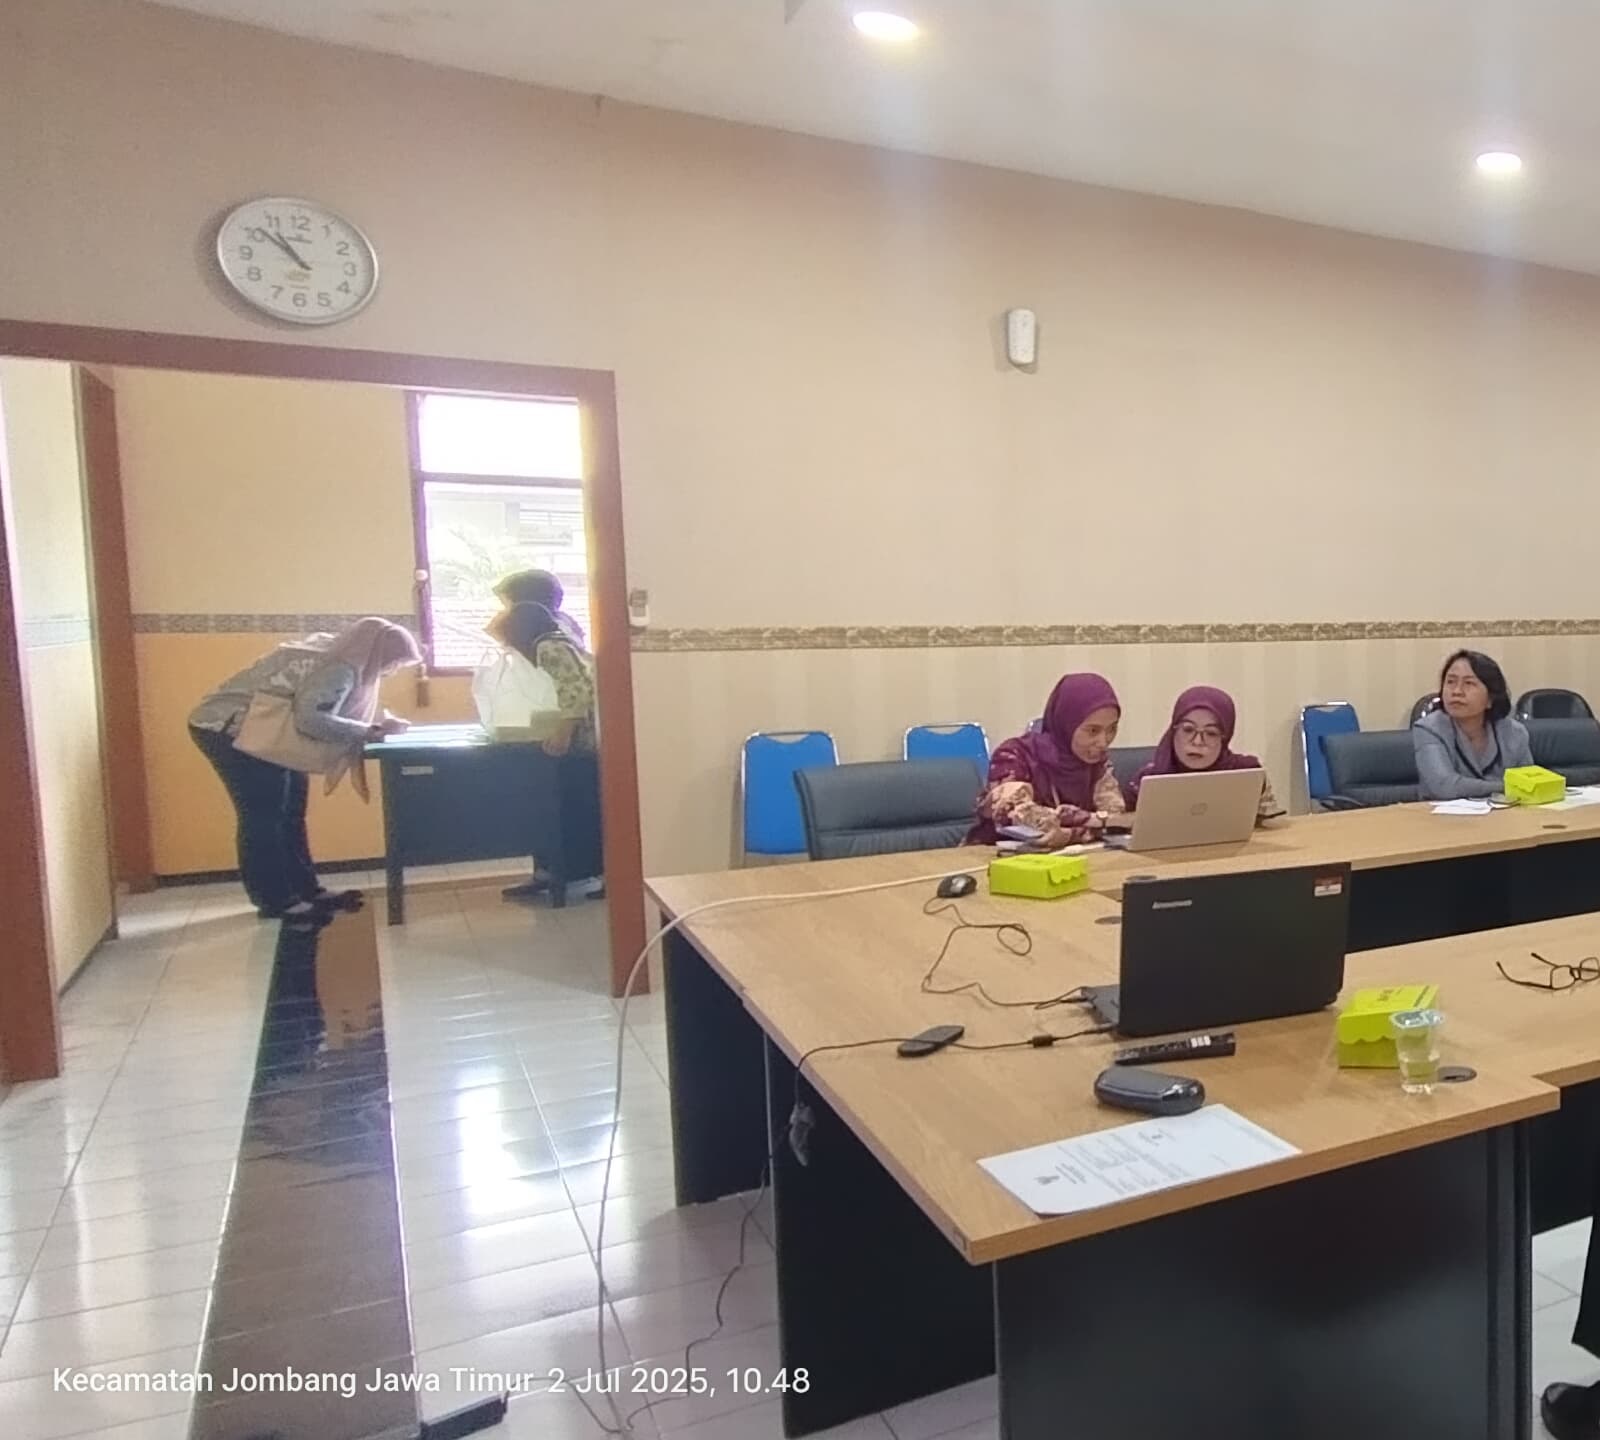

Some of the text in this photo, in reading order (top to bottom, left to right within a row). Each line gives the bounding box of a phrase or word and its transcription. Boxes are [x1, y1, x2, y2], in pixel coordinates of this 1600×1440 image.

[290, 215, 311, 232] 12
[239, 245, 253, 260] 9
[336, 241, 350, 256] 2
[247, 266, 262, 282] 8
[344, 262, 357, 277] 3
[271, 285, 284, 299] 7
[337, 281, 350, 294] 4
[292, 293, 307, 308] 6
[317, 292, 331, 307] 5
